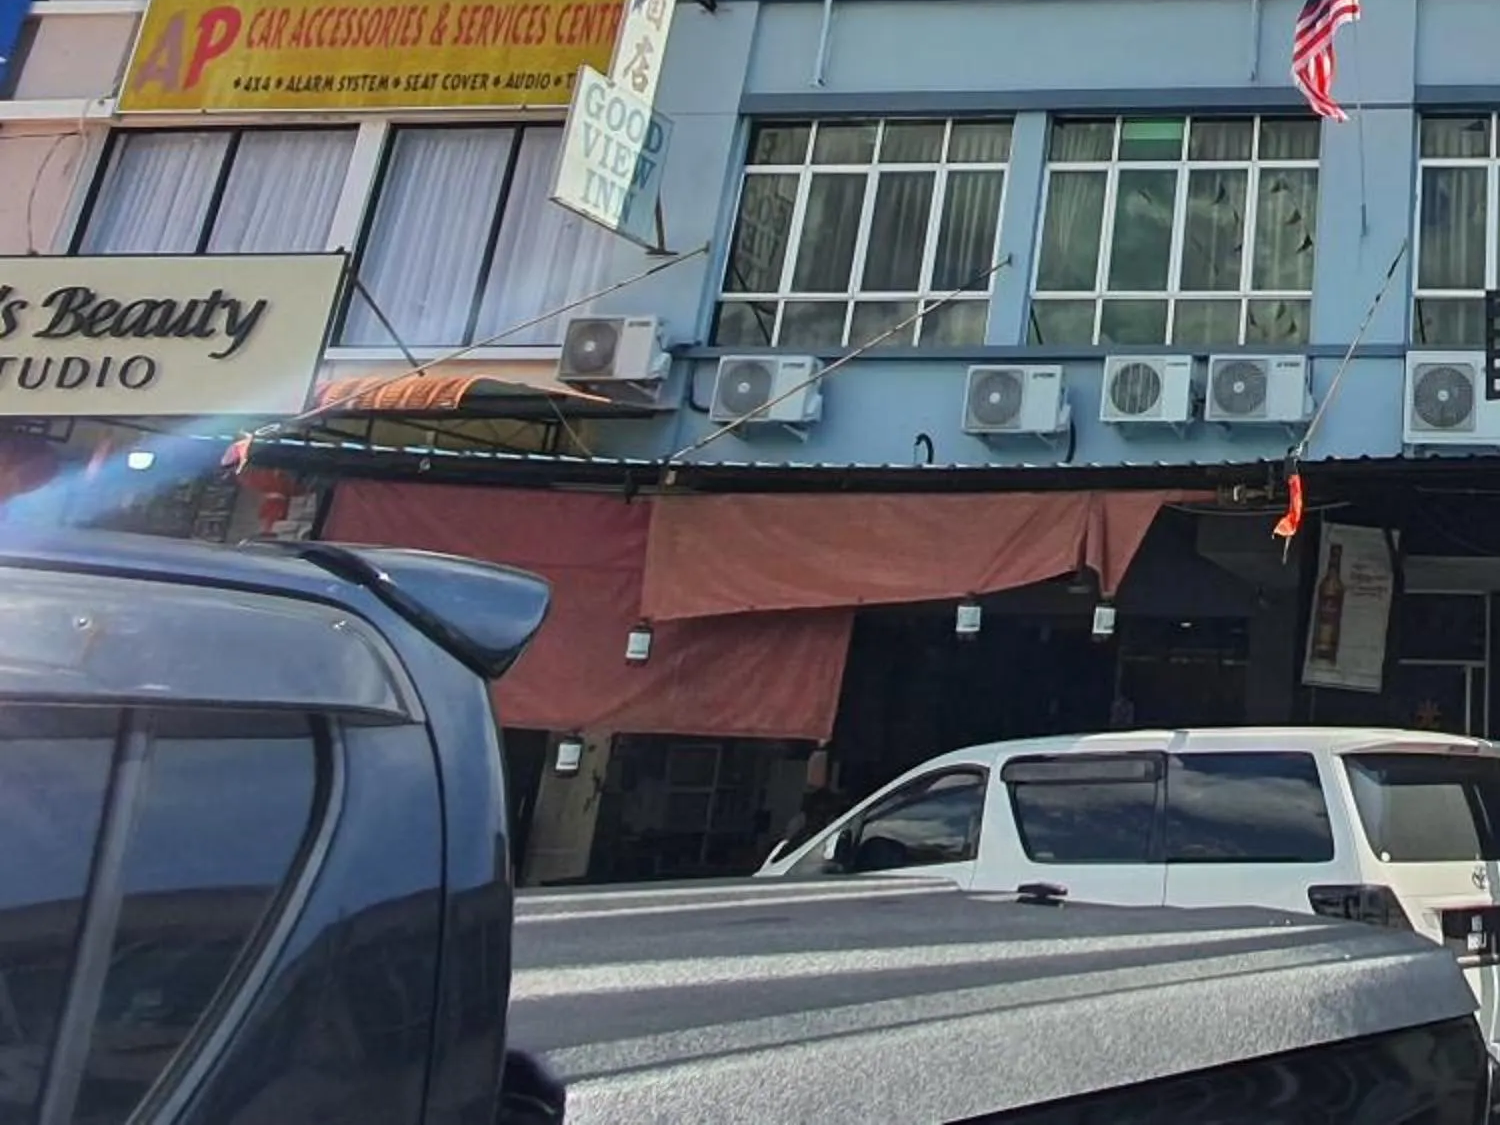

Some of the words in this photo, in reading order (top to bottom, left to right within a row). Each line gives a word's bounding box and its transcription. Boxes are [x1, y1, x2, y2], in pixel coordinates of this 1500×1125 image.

[132, 5, 243, 93] AP
[245, 6, 291, 49] CAR
[290, 4, 429, 49] ACCESSORIES
[430, 2, 450, 47] &
[453, 2, 552, 47] SERVICES
[286, 74, 334, 92] ALARM
[336, 73, 390, 92] SYSTEM
[403, 73, 437, 92] SEAT
[441, 72, 489, 91] COVER
[505, 72, 550, 91] AUDIO
[584, 81, 664, 154] GOOD
[582, 122, 657, 191] VIEW
[32, 286, 268, 360] Beauty
